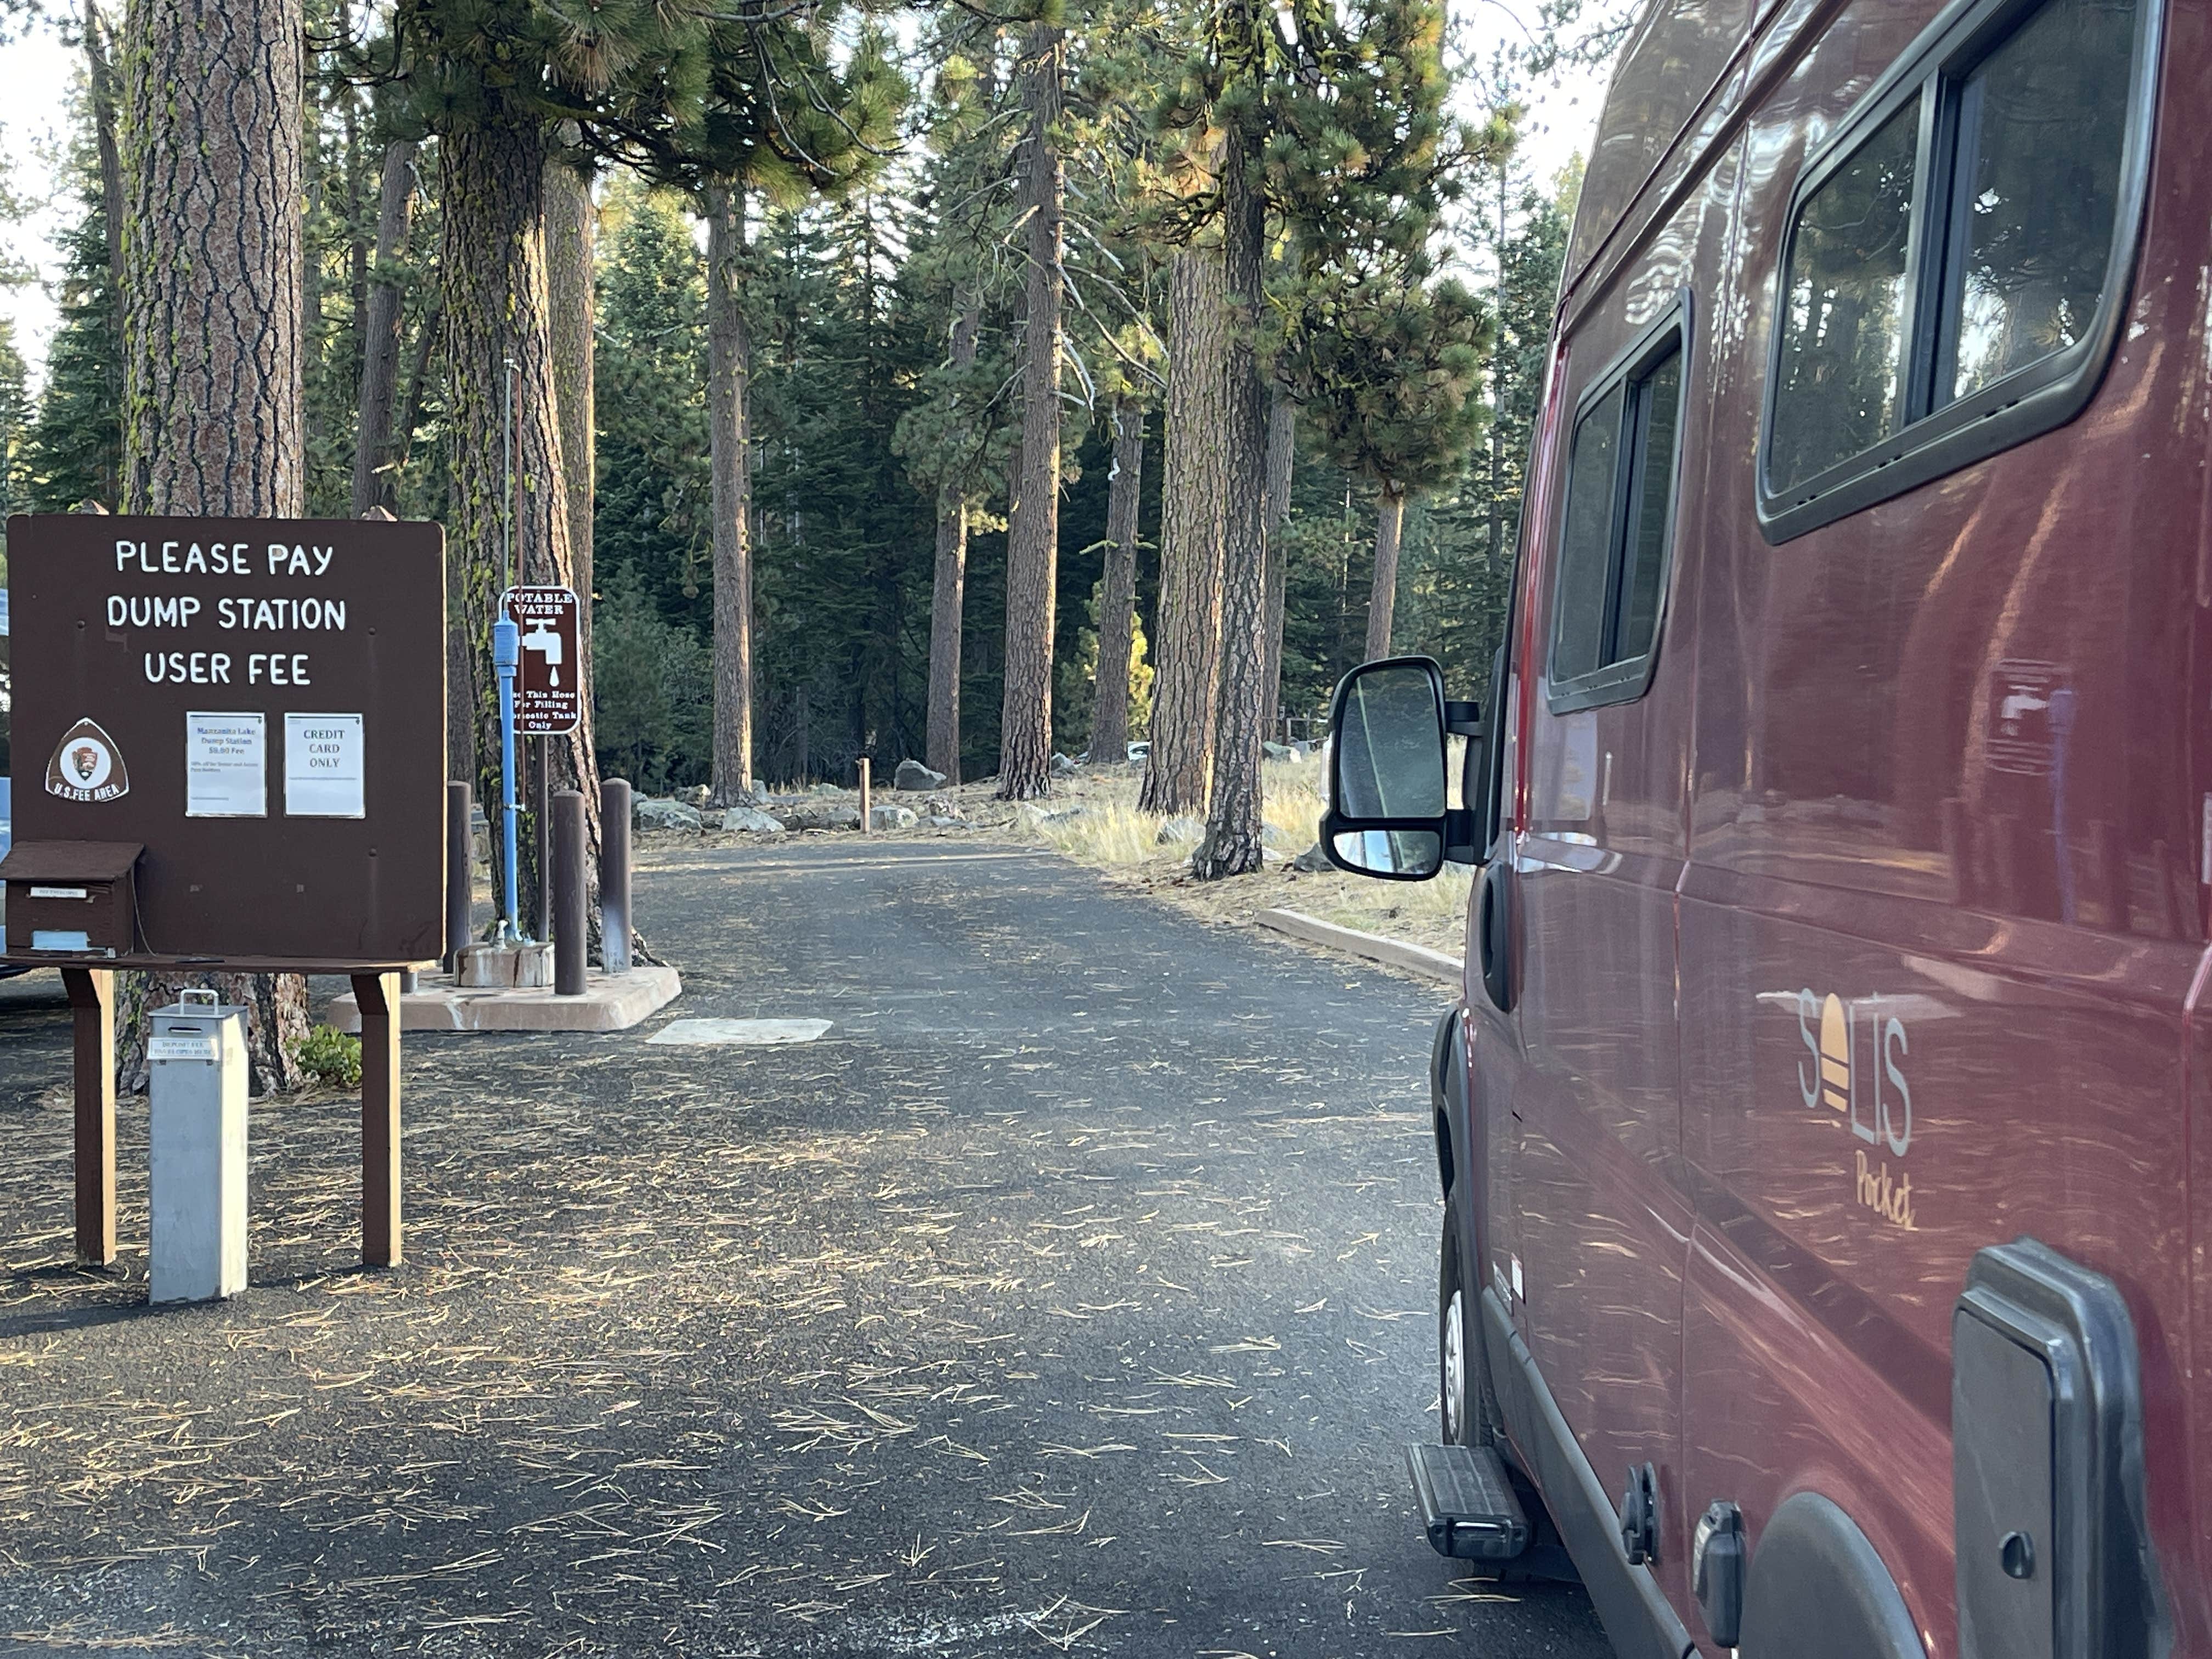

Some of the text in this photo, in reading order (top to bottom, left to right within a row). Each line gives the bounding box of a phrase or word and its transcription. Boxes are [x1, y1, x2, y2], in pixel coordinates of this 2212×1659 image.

[116, 541, 334, 576] PLEASE PAY
[507, 593, 573, 603] POTABLE
[108, 596, 346, 631] DUMP STATION
[514, 605, 563, 614] WATER
[145, 653, 311, 686] USER FEE
[534, 701, 568, 709] Filling
[528, 721, 552, 730] Only
[304, 730, 345, 739] CREDIT
[309, 744, 340, 753] CARD
[310, 758, 340, 768] ONLY
[94, 783, 120, 800] AREA
